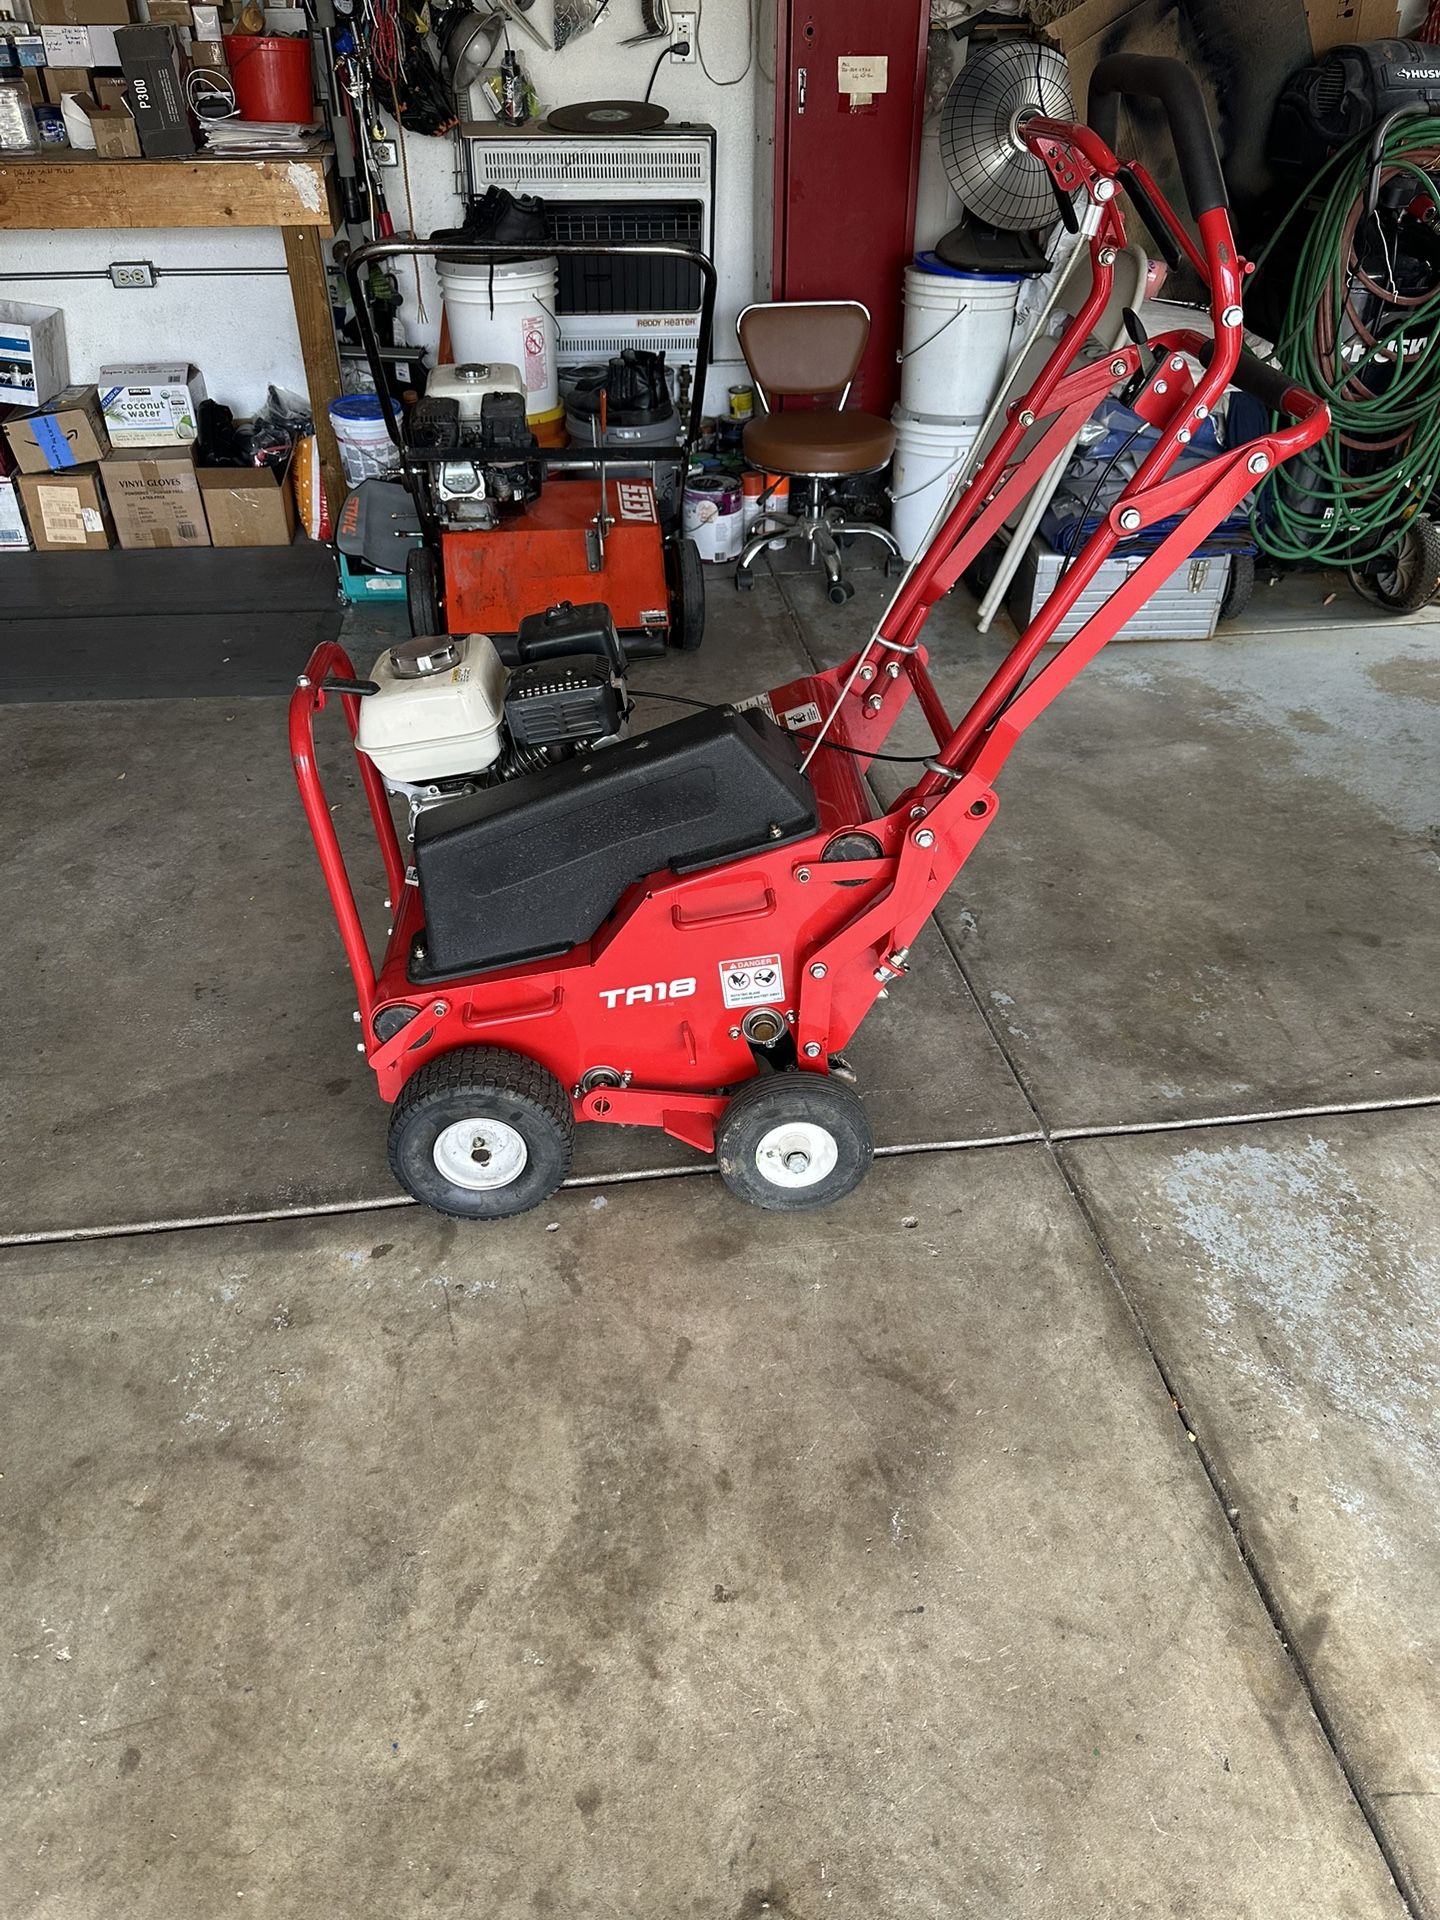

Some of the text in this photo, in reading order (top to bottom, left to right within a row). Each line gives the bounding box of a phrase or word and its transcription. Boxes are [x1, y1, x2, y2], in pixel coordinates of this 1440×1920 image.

[133, 79, 152, 109] P300
[121, 401, 166, 411] coconut
[128, 410, 161, 418] water
[119, 479, 181, 488] VINYL GLOVES
[621, 484, 653, 522] KEES
[737, 958, 772, 969] DANGER
[598, 976, 697, 1009] TA18
